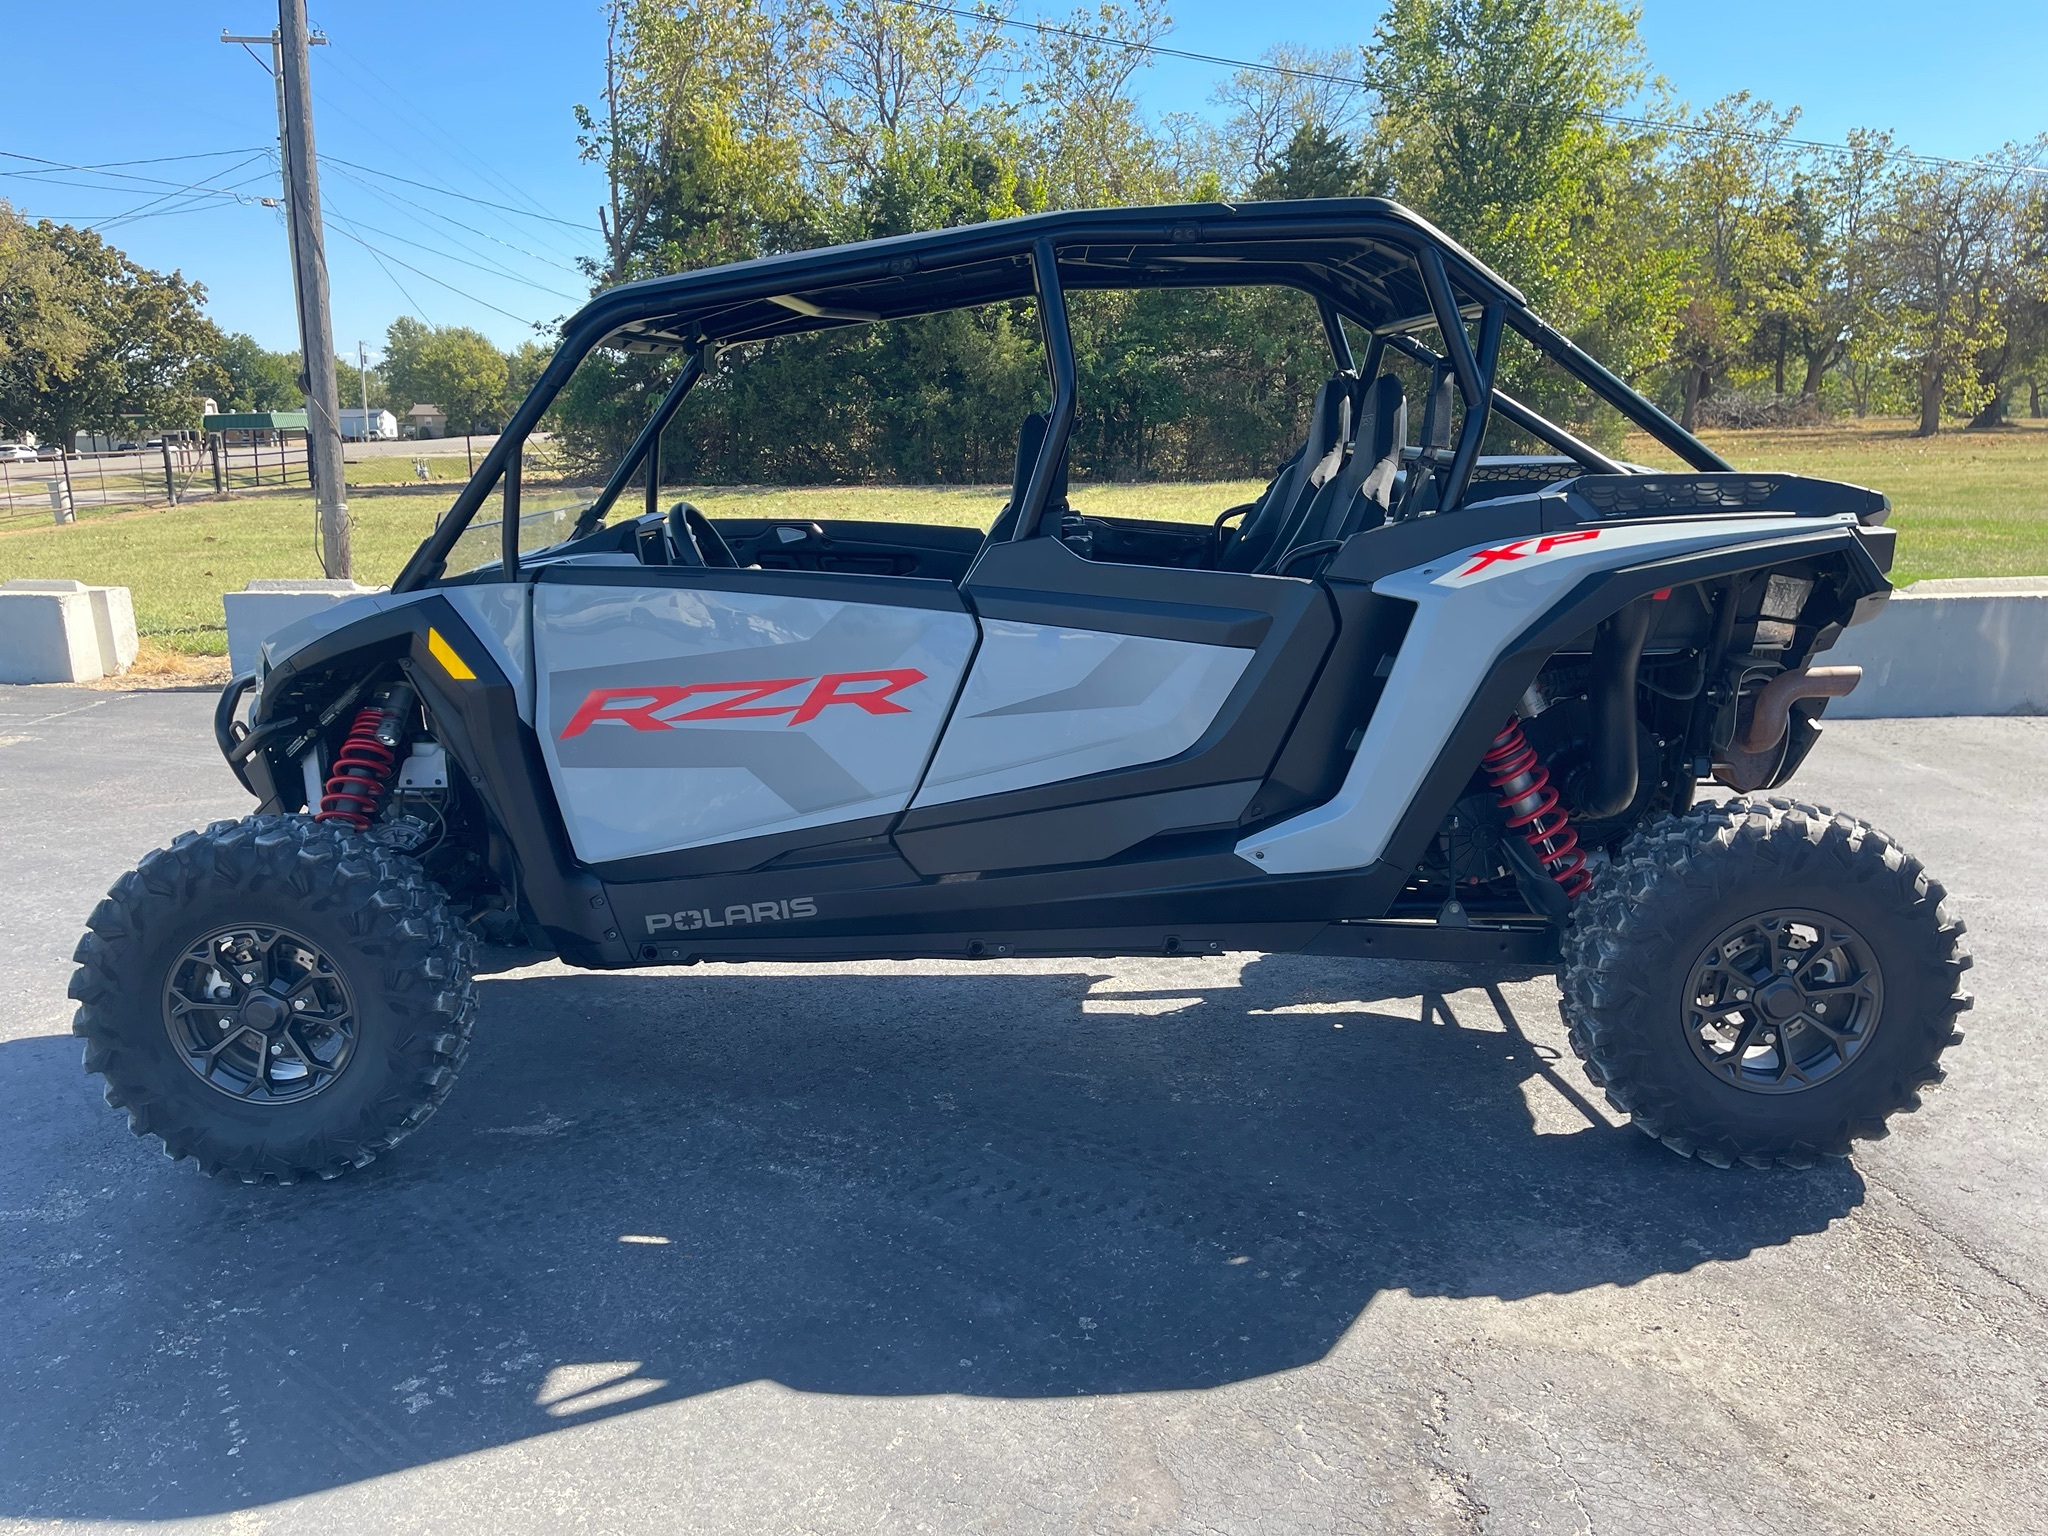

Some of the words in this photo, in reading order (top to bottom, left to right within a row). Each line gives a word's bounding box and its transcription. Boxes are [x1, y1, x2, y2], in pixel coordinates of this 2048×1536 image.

[1456, 530, 1601, 579] XP
[558, 668, 929, 741] RZR
[645, 897, 818, 935] POLARIS
